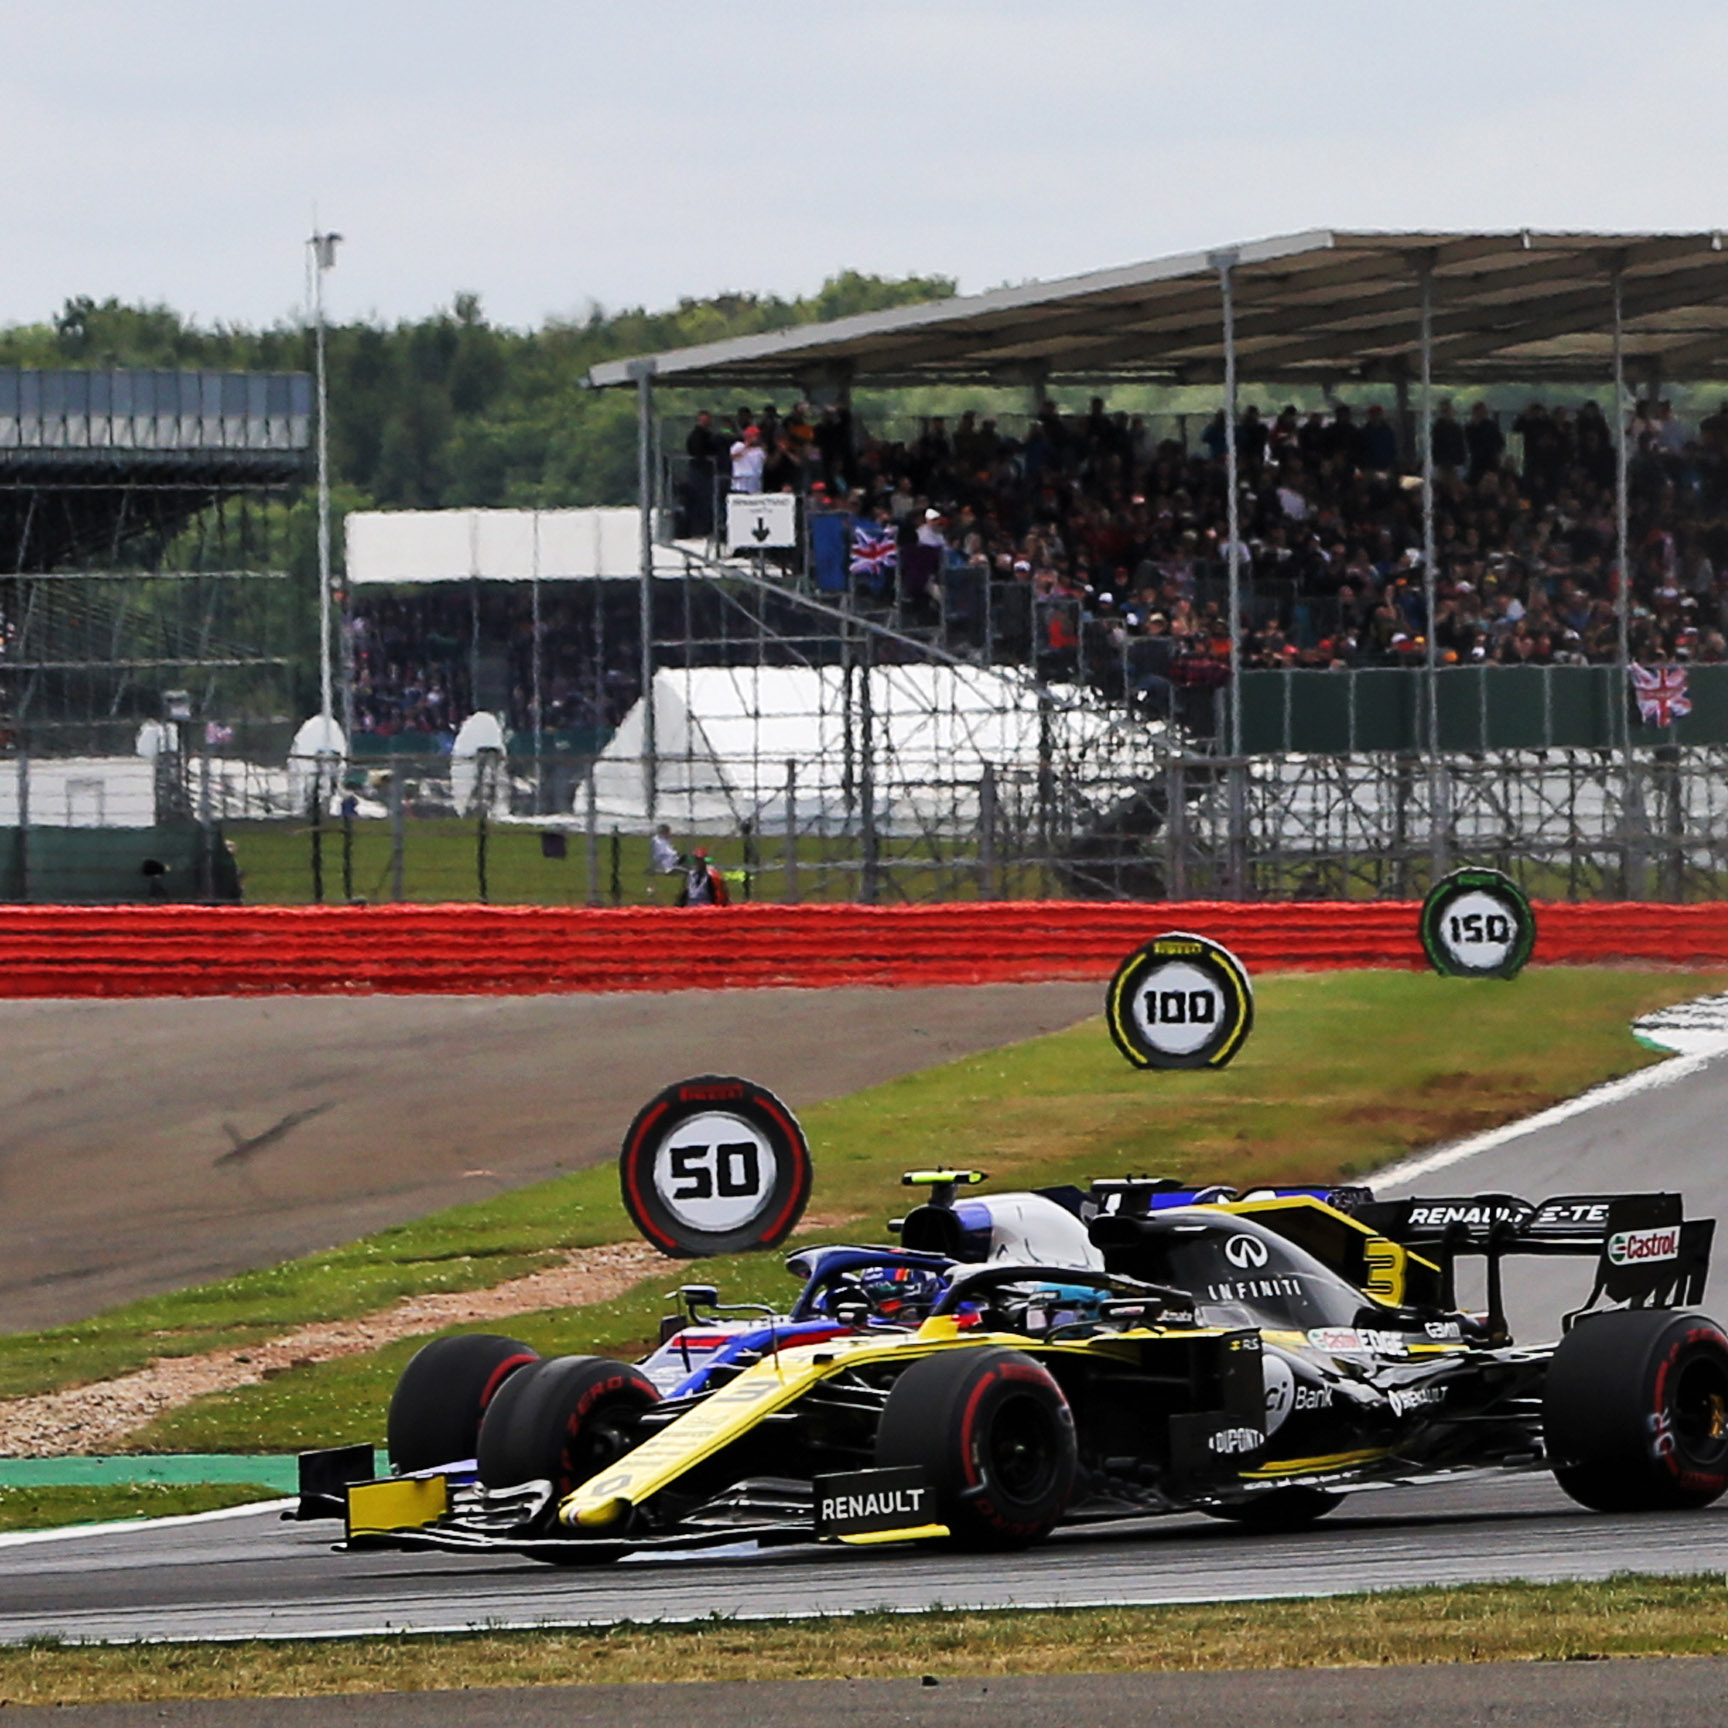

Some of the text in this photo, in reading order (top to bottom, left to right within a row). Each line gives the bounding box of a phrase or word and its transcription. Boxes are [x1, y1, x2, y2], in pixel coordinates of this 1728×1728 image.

[1450, 914, 1509, 943] 150
[1143, 990, 1215, 1024] 100
[670, 1141, 760, 1199] 50
[1539, 1204, 1610, 1222] E-TE
[1626, 1230, 1677, 1260] Castrol
[1362, 1238, 1407, 1308] 3
[1207, 1277, 1303, 1302] INFINITI
[1294, 1383, 1333, 1410] Bank
[821, 1488, 925, 1521] RENAULT
